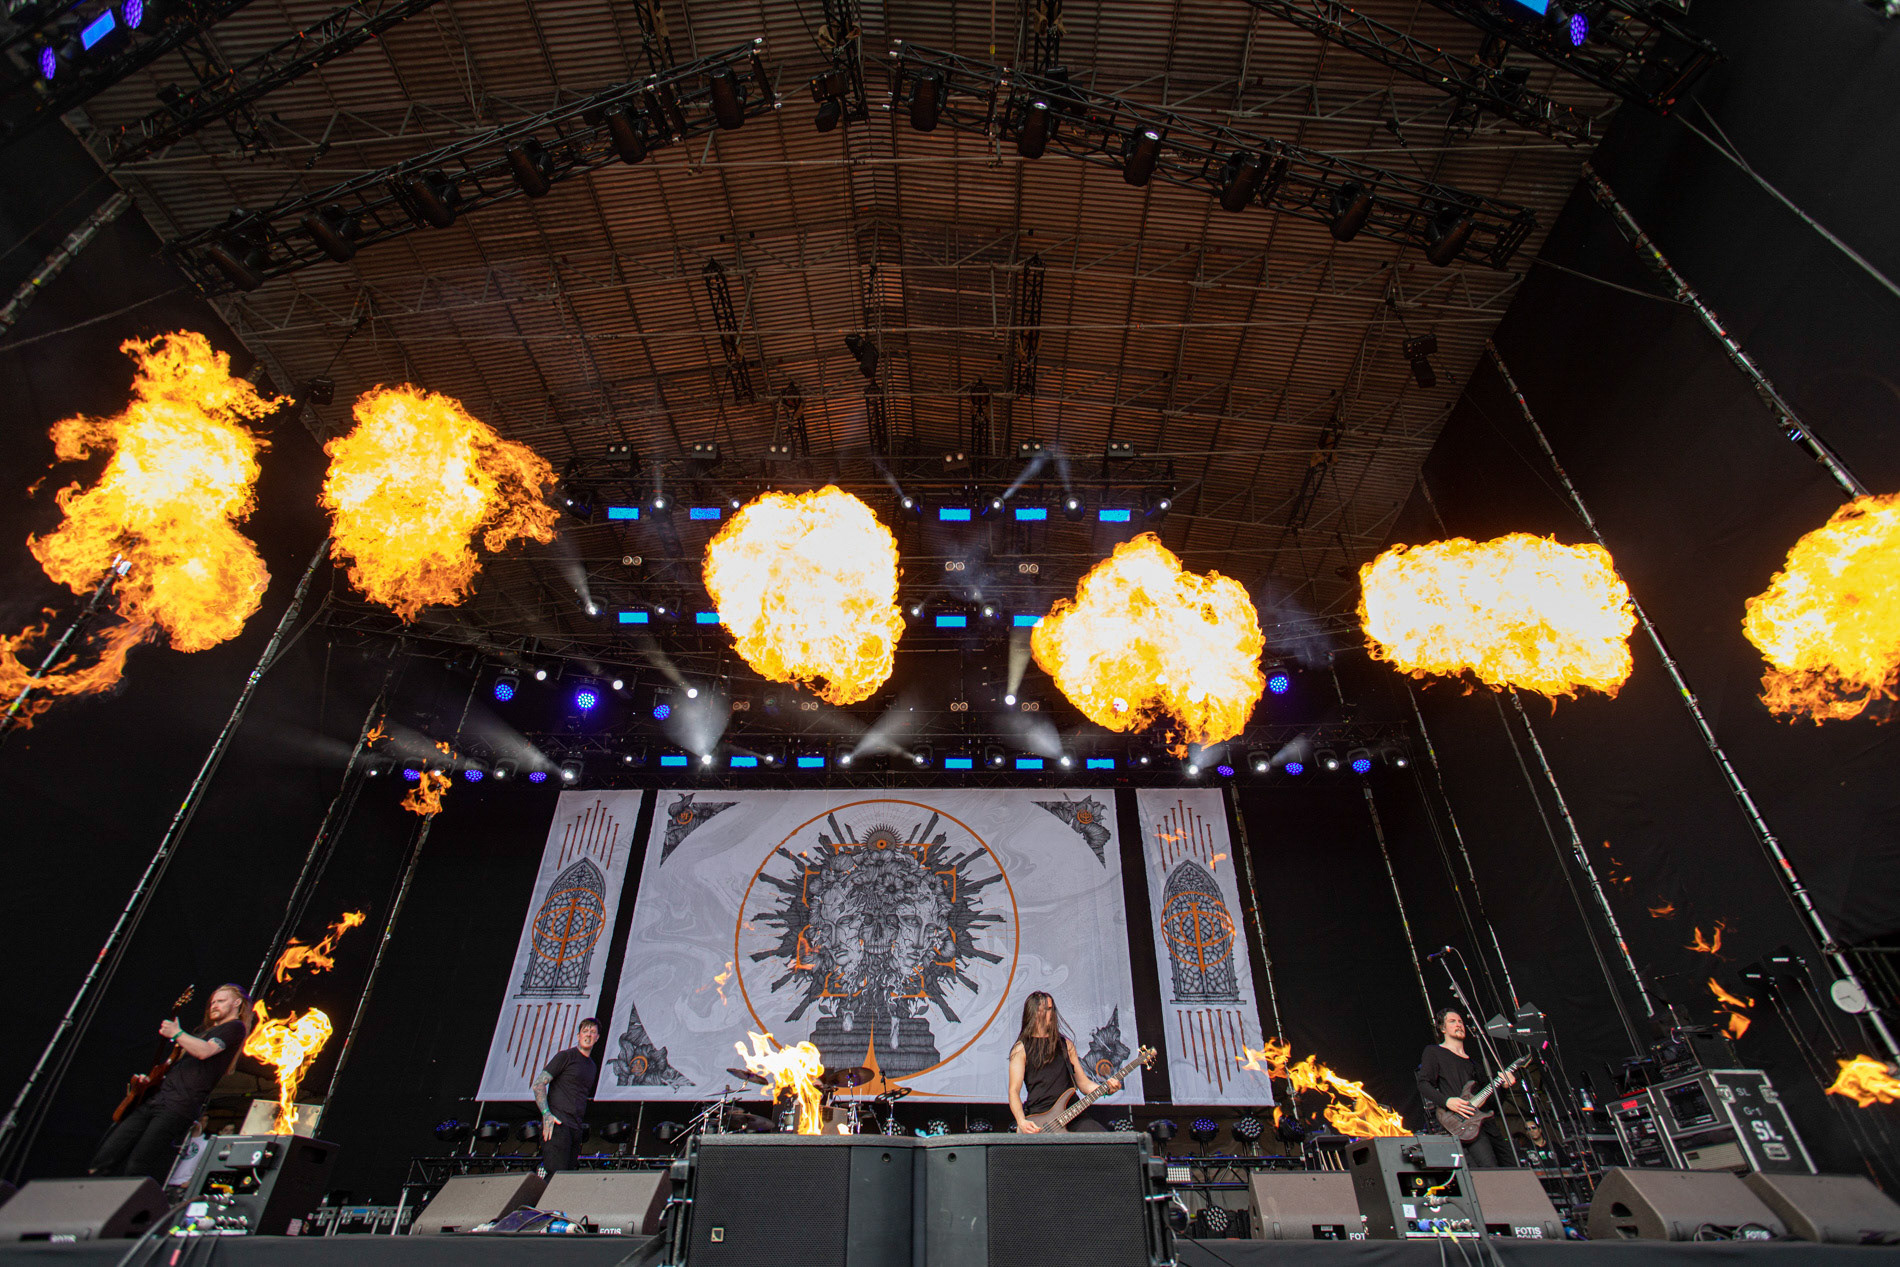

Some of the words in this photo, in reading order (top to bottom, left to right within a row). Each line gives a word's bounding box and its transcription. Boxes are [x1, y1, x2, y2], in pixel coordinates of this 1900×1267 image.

[1735, 1087, 1751, 1097] SL
[1751, 1120, 1784, 1141] SL
[1514, 1226, 1542, 1235] FOTIS
